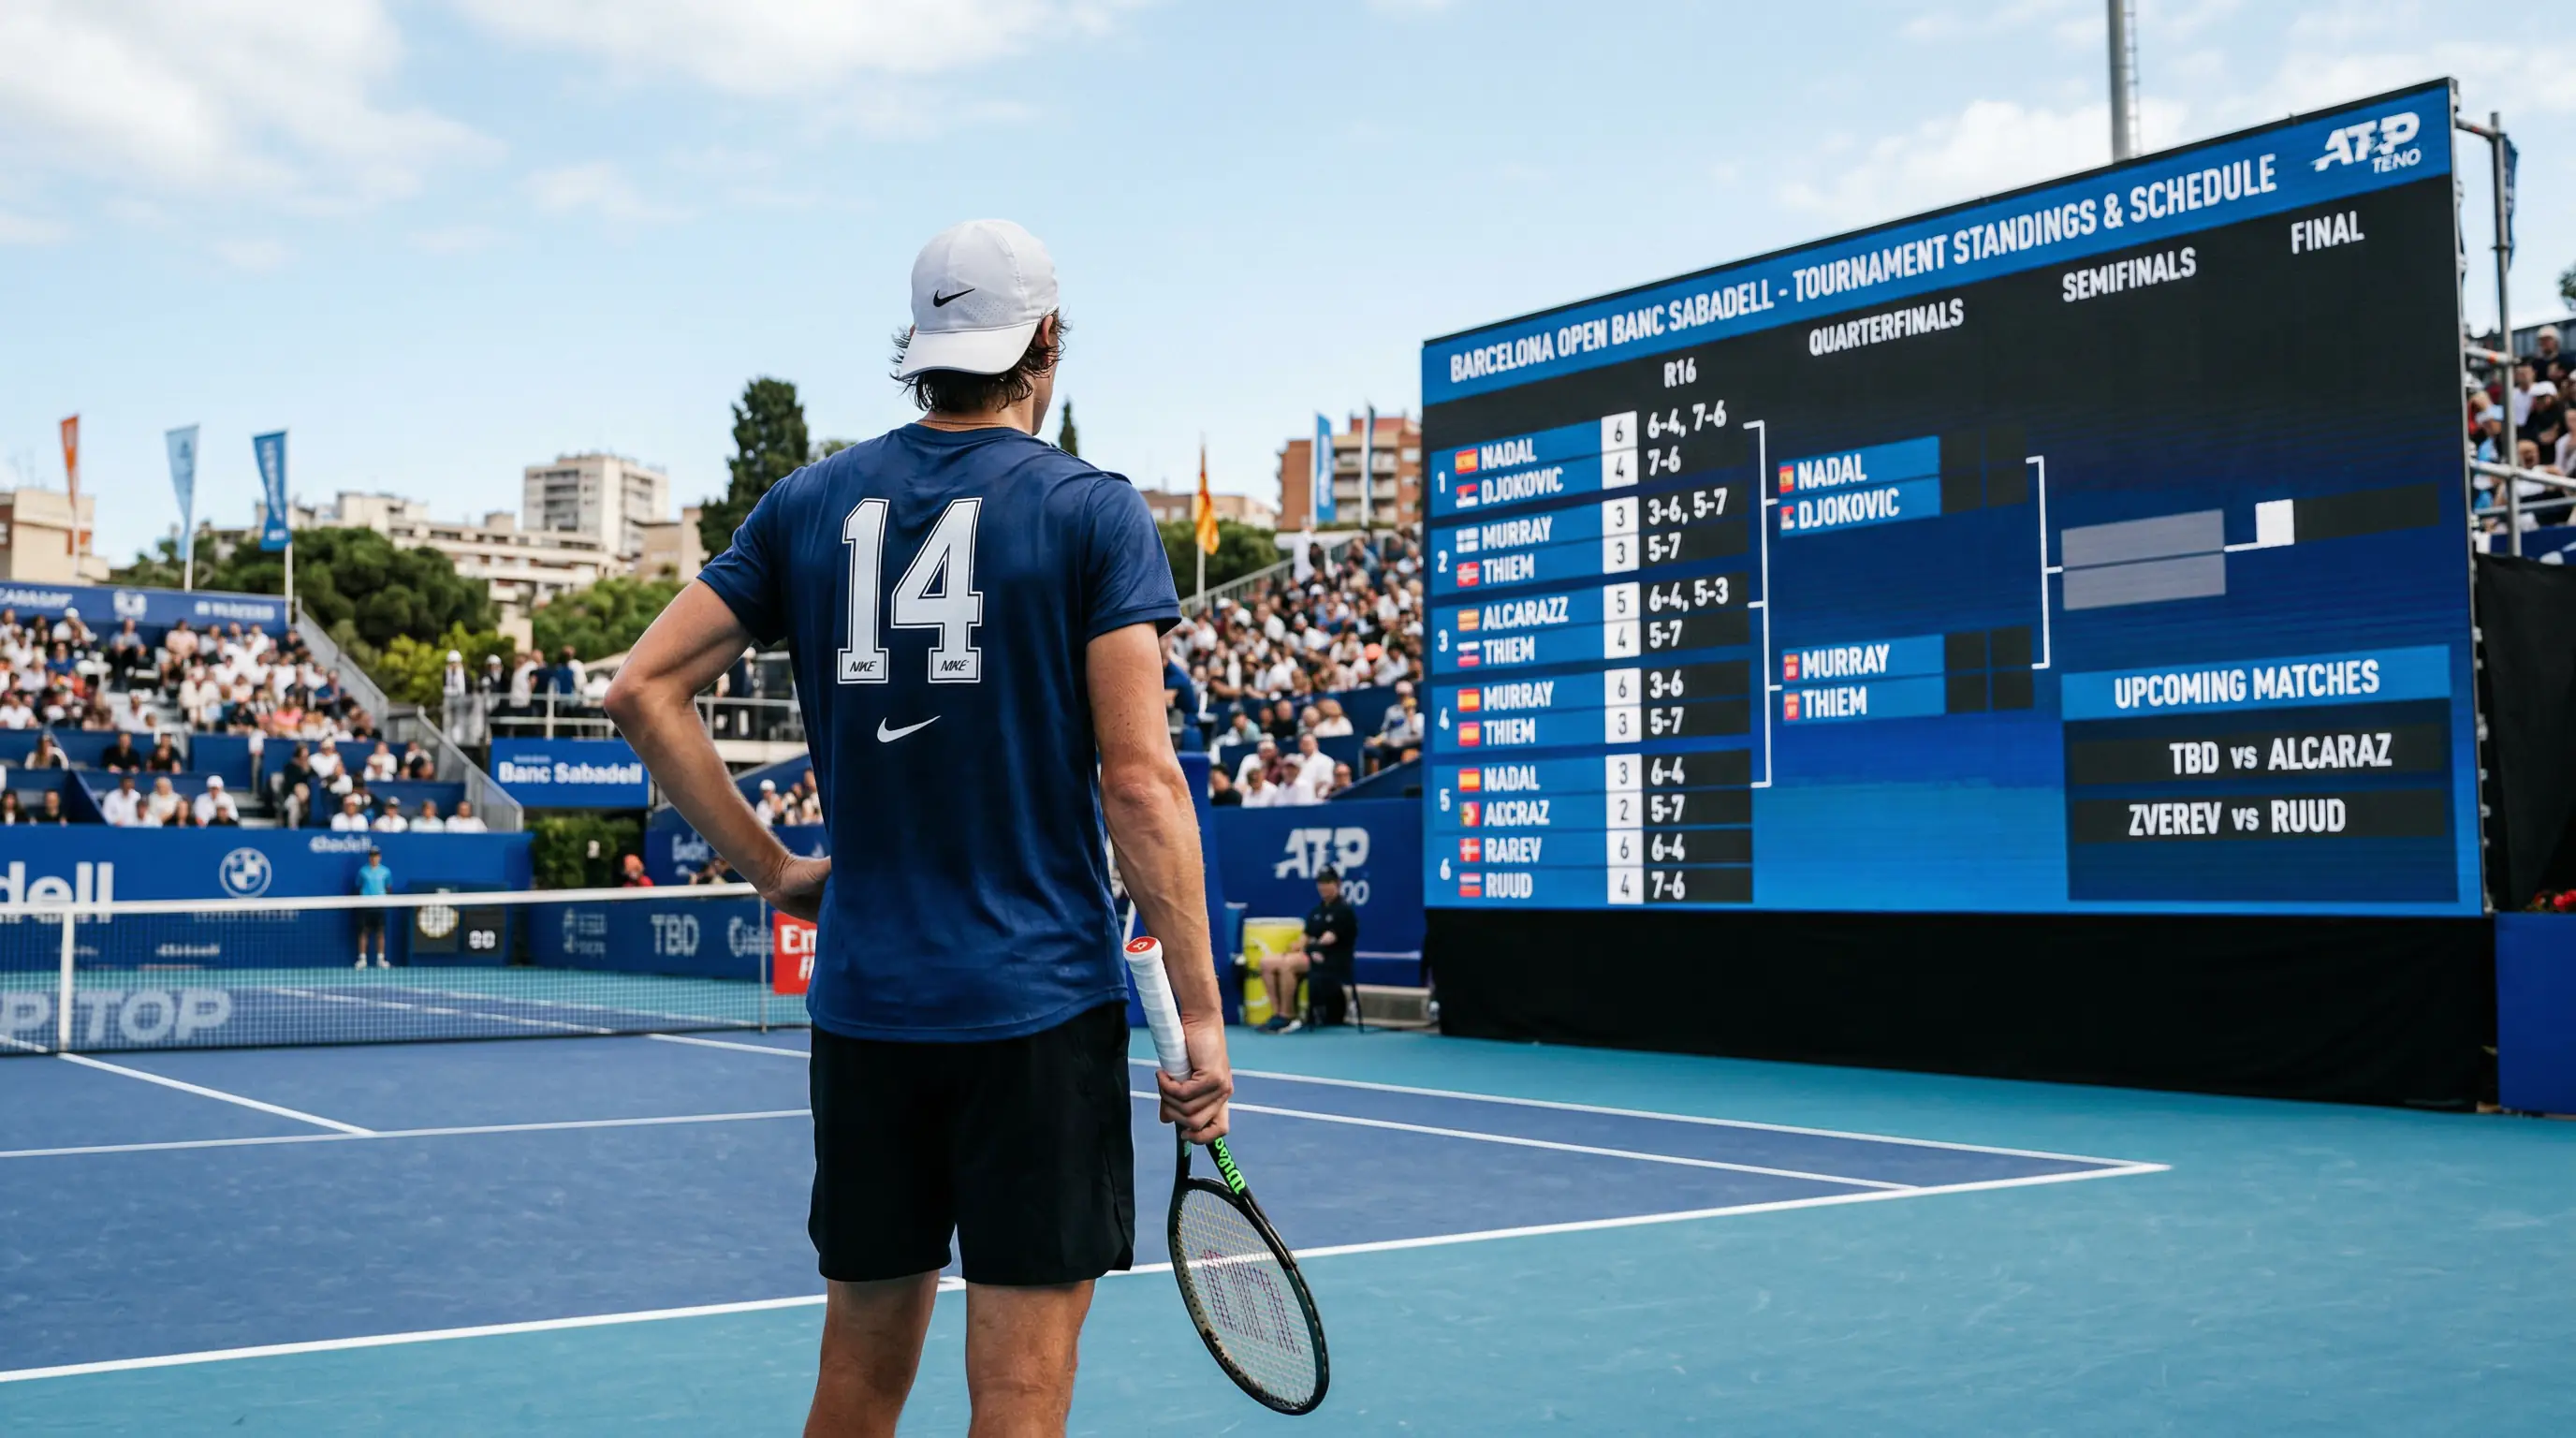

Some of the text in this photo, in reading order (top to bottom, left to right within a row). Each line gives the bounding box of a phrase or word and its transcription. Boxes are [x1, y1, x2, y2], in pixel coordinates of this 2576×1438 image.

[2315, 112, 2421, 172] ATP
[2373, 148, 2421, 172] TENO
[2291, 211, 2364, 254] FINAL
[1450, 332, 1555, 383] BARCELONA
[1558, 318, 1607, 357] OPEN
[1612, 305, 1665, 345] BANC
[1669, 279, 1775, 331] SABADELL
[1793, 234, 1948, 302] TOURNAMENT
[1954, 198, 2097, 264] STANDINGS
[2103, 193, 2124, 229] &
[2130, 154, 2276, 223] SCHEDULE
[2062, 246, 2196, 302] SEMIFINALS
[1808, 298, 1964, 357] QUARTERFINALS
[1664, 357, 1697, 388] R16
[1614, 420, 1624, 444] 6
[1647, 399, 1727, 439] 6-4, 7-6
[1481, 438, 1537, 470] NADAL
[1647, 446, 1681, 477] 7-6
[1438, 471, 1445, 493] 1
[1615, 459, 1625, 479] 4
[1797, 453, 1867, 490] NADAL
[1481, 466, 1563, 505] DJOKOVIC
[1616, 506, 1625, 527] 3
[1647, 487, 1728, 525] 3-6, 5-7
[1798, 487, 1900, 529] DJOKOVIC
[1482, 517, 1552, 550] MURRAY
[1648, 532, 1682, 562] 5-7
[1438, 550, 1448, 573] 2
[1482, 553, 1535, 583] THIEM
[1616, 543, 1625, 565] 3
[837, 496, 983, 684] 14
[1617, 592, 1627, 614] 5
[1648, 577, 1729, 612] 6-4, 5-3
[1482, 596, 1569, 631] ALCARAZZ
[1439, 629, 1448, 653] 3
[1617, 629, 1627, 650] 4
[1649, 619, 1683, 649] 5-7
[1483, 636, 1535, 665] THIEM
[1802, 643, 1890, 679] MURRAY
[1484, 681, 1554, 712] MURRAY
[1617, 676, 1627, 699] 6
[1649, 669, 1684, 699] 3-6
[2115, 659, 2379, 709] UPCOMING MATCHES
[1802, 686, 1867, 719] THIEM
[1439, 709, 1450, 729] 4
[1483, 718, 1536, 745] THIEM
[1617, 713, 1628, 735] 3
[1650, 706, 1684, 735] 5-7
[2169, 741, 2219, 775] TBD
[2267, 732, 2393, 770] ALCARAZ
[498, 761, 643, 784] Banc Sabadell
[1484, 765, 1540, 792] NADAL
[1618, 763, 1629, 785] 3
[1650, 756, 1685, 785] 6-4
[1440, 788, 1450, 812] 5
[1619, 799, 1630, 822] 2
[1650, 794, 1685, 823] 5-7
[2129, 801, 2222, 836] ZVEREV
[2271, 799, 2346, 833] RUUD
[1272, 827, 1370, 879] ATP
[1485, 837, 1542, 863] RAREV
[1619, 836, 1629, 859] 6
[1651, 833, 1685, 861] 6-4
[1440, 858, 1451, 880] 6
[1486, 873, 1533, 899] RUUD
[1620, 873, 1631, 897] 4
[1651, 871, 1686, 900] 7-6
[651, 914, 700, 957] TBD
[77, 989, 232, 1043] TOP
